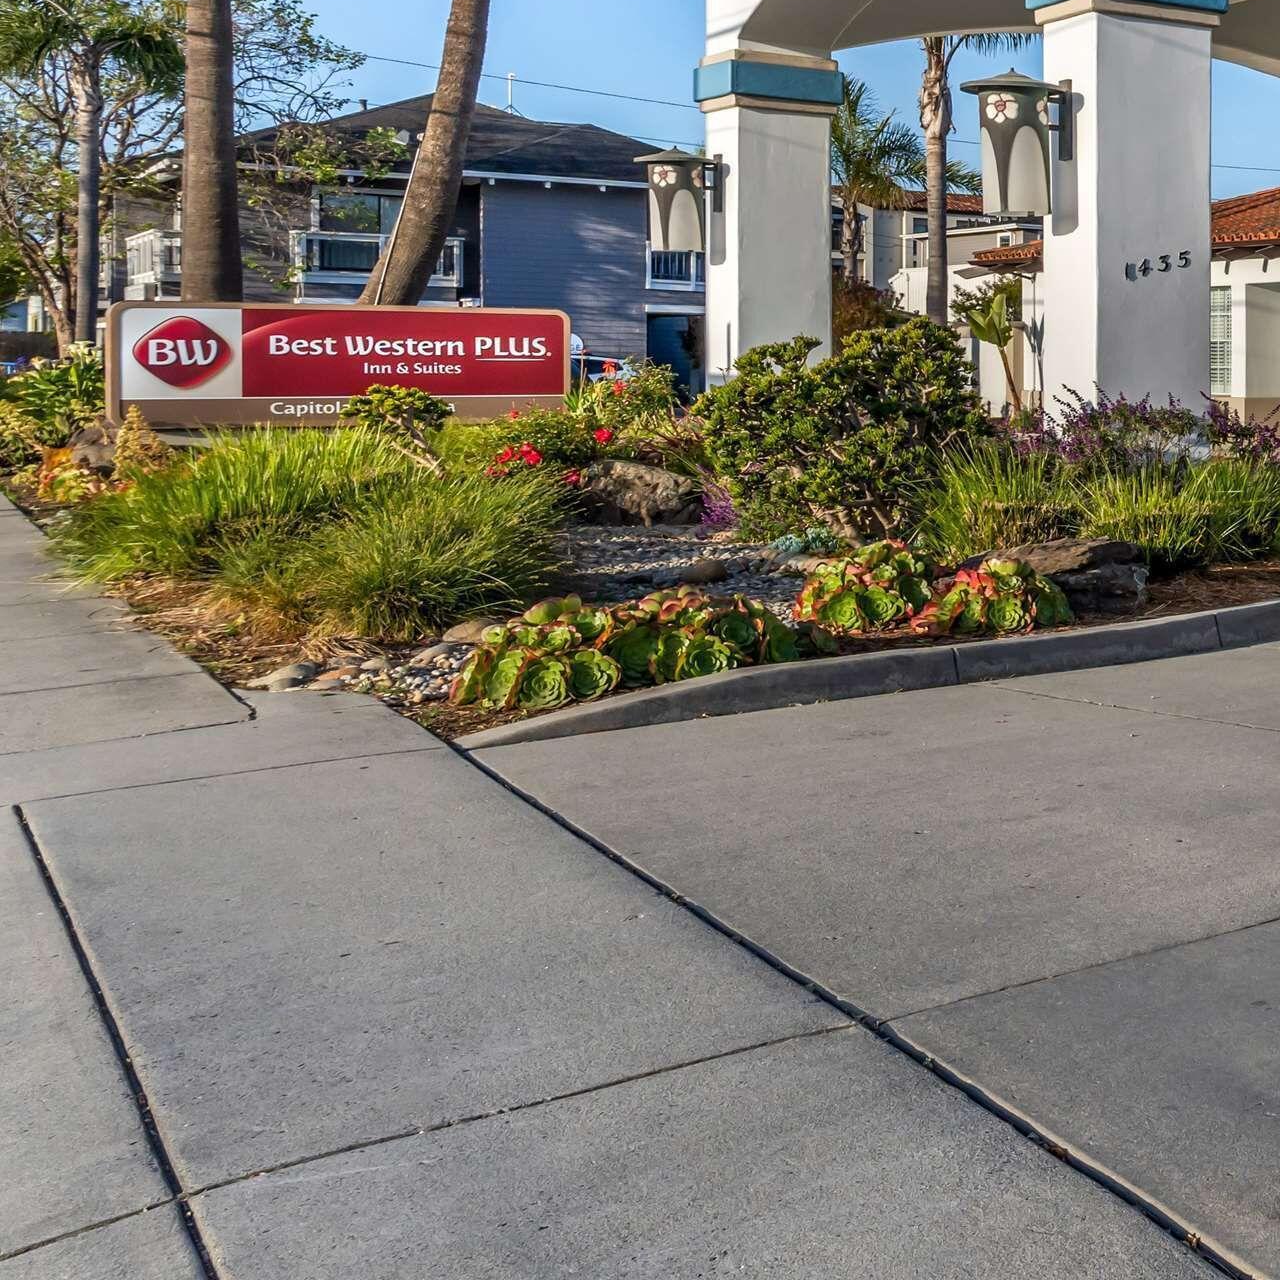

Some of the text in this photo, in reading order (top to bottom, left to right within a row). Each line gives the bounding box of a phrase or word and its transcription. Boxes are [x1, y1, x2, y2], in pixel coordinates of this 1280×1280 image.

[1125, 250, 1192, 281] 1435
[148, 338, 218, 366] BW
[269, 335, 338, 356] Best
[344, 335, 466, 356] Western
[474, 336, 547, 357] PLUS
[363, 362, 462, 375] Inn & Suites
